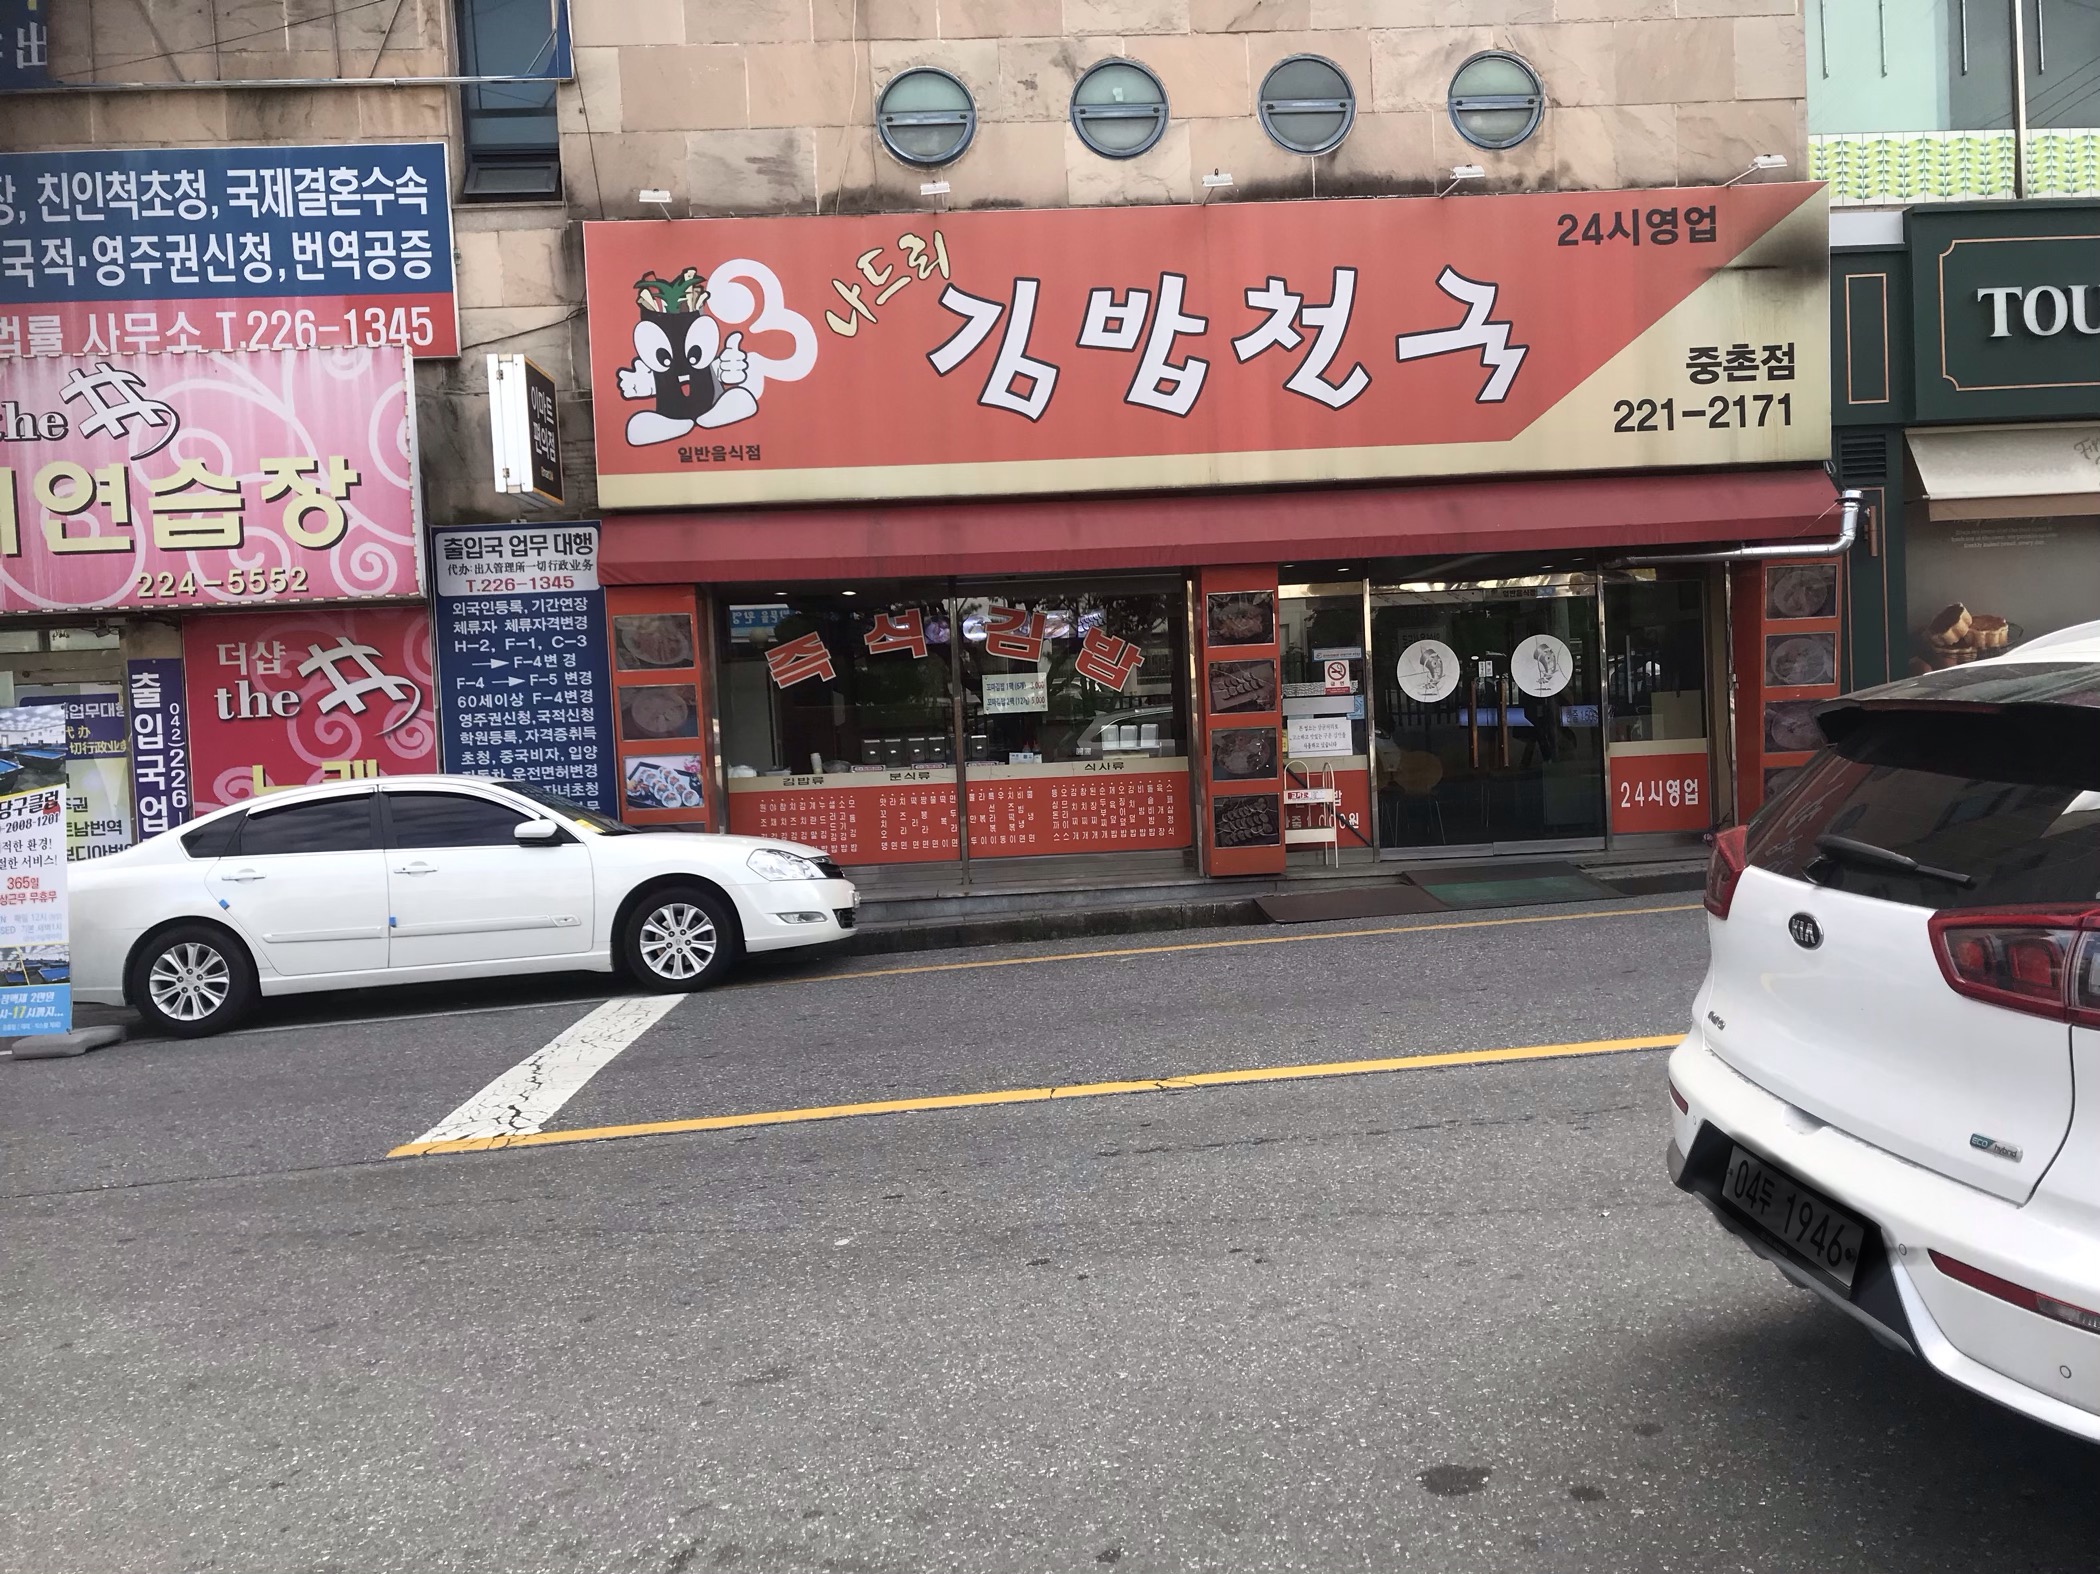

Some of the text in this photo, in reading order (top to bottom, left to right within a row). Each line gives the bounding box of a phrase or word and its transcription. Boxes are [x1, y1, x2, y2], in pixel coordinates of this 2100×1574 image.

[37, 169, 219, 222] 친인척초청,
[226, 165, 428, 218] 국제결혼수속
[1557, 205, 1717, 246] 24시영업
[82, 311, 202, 354] 사무소
[216, 306, 433, 352] T.226-1345
[926, 264, 1530, 423] 김밥천국
[1685, 342, 1795, 384] 중촌점
[531, 386, 555, 425] 이마트
[1613, 393, 1792, 433] 221-2171
[0, 401, 68, 441] he
[533, 421, 557, 463] 편의점
[677, 444, 762, 463] 일반음식점
[0, 455, 361, 556] 연습장
[444, 532, 594, 560] 출입국 업무 대행
[137, 566, 309, 598] 224-5552
[466, 575, 575, 593] T.226-1345
[453, 597, 588, 616] 외국인등록, 기간연장
[453, 616, 588, 635] 체류자 체류자격변경
[216, 641, 286, 675] 더샵
[455, 636, 587, 653] H-2, F-1, C-3
[456, 671, 592, 689] F-4 F-5 변경
[214, 681, 300, 720] the
[457, 692, 524, 708] 60세이상
[459, 726, 597, 746] 학원등록, 자격증취득
[461, 745, 598, 766] 초청, 중국비자, 입양
[1085, 762, 1124, 771] 식사류
[783, 776, 824, 786] 김밥류
[890, 772, 930, 781] 분식류
[1620, 778, 1698, 808] 24시영업
[1791, 918, 1816, 944] KIA
[1971, 1136, 1988, 1147] ECO
[1783, 1192, 1846, 1267] 1946
